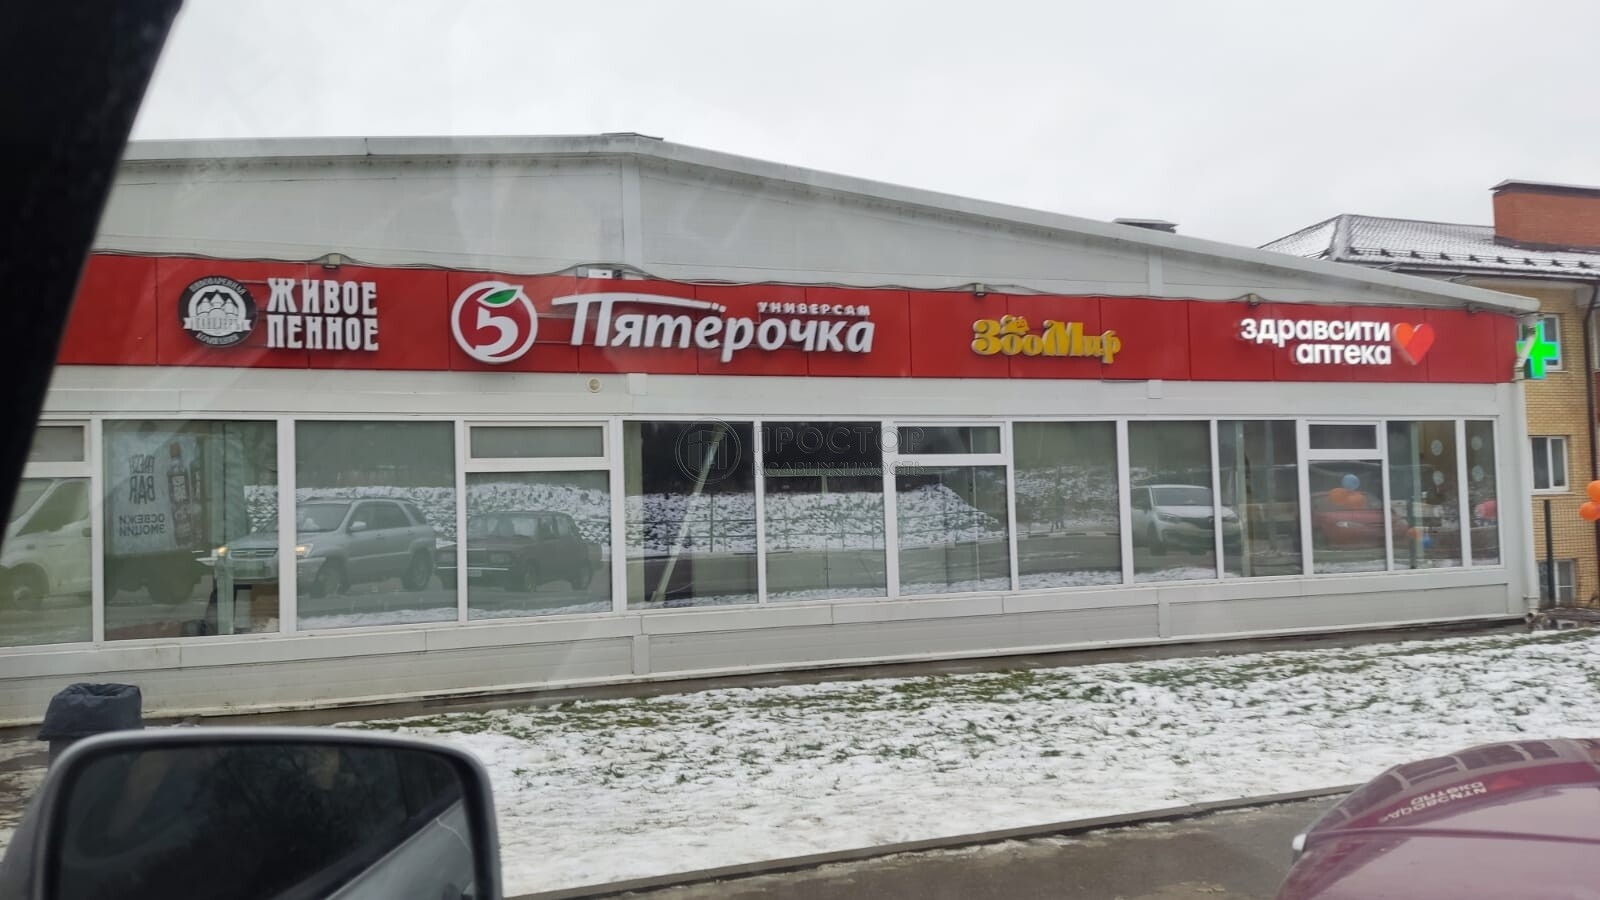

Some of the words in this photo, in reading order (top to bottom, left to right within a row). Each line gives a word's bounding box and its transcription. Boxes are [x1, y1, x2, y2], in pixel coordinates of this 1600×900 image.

[266, 277, 378, 316] ЖИВОЕ
[757, 301, 871, 316] УНИВЕРСАМ
[266, 315, 379, 350] ПЕННОЕ
[551, 292, 876, 363] Пятёрочка
[971, 317, 1122, 364] ЗооМир
[1240, 317, 1391, 347] здравсити
[1294, 340, 1392, 366] аптека
